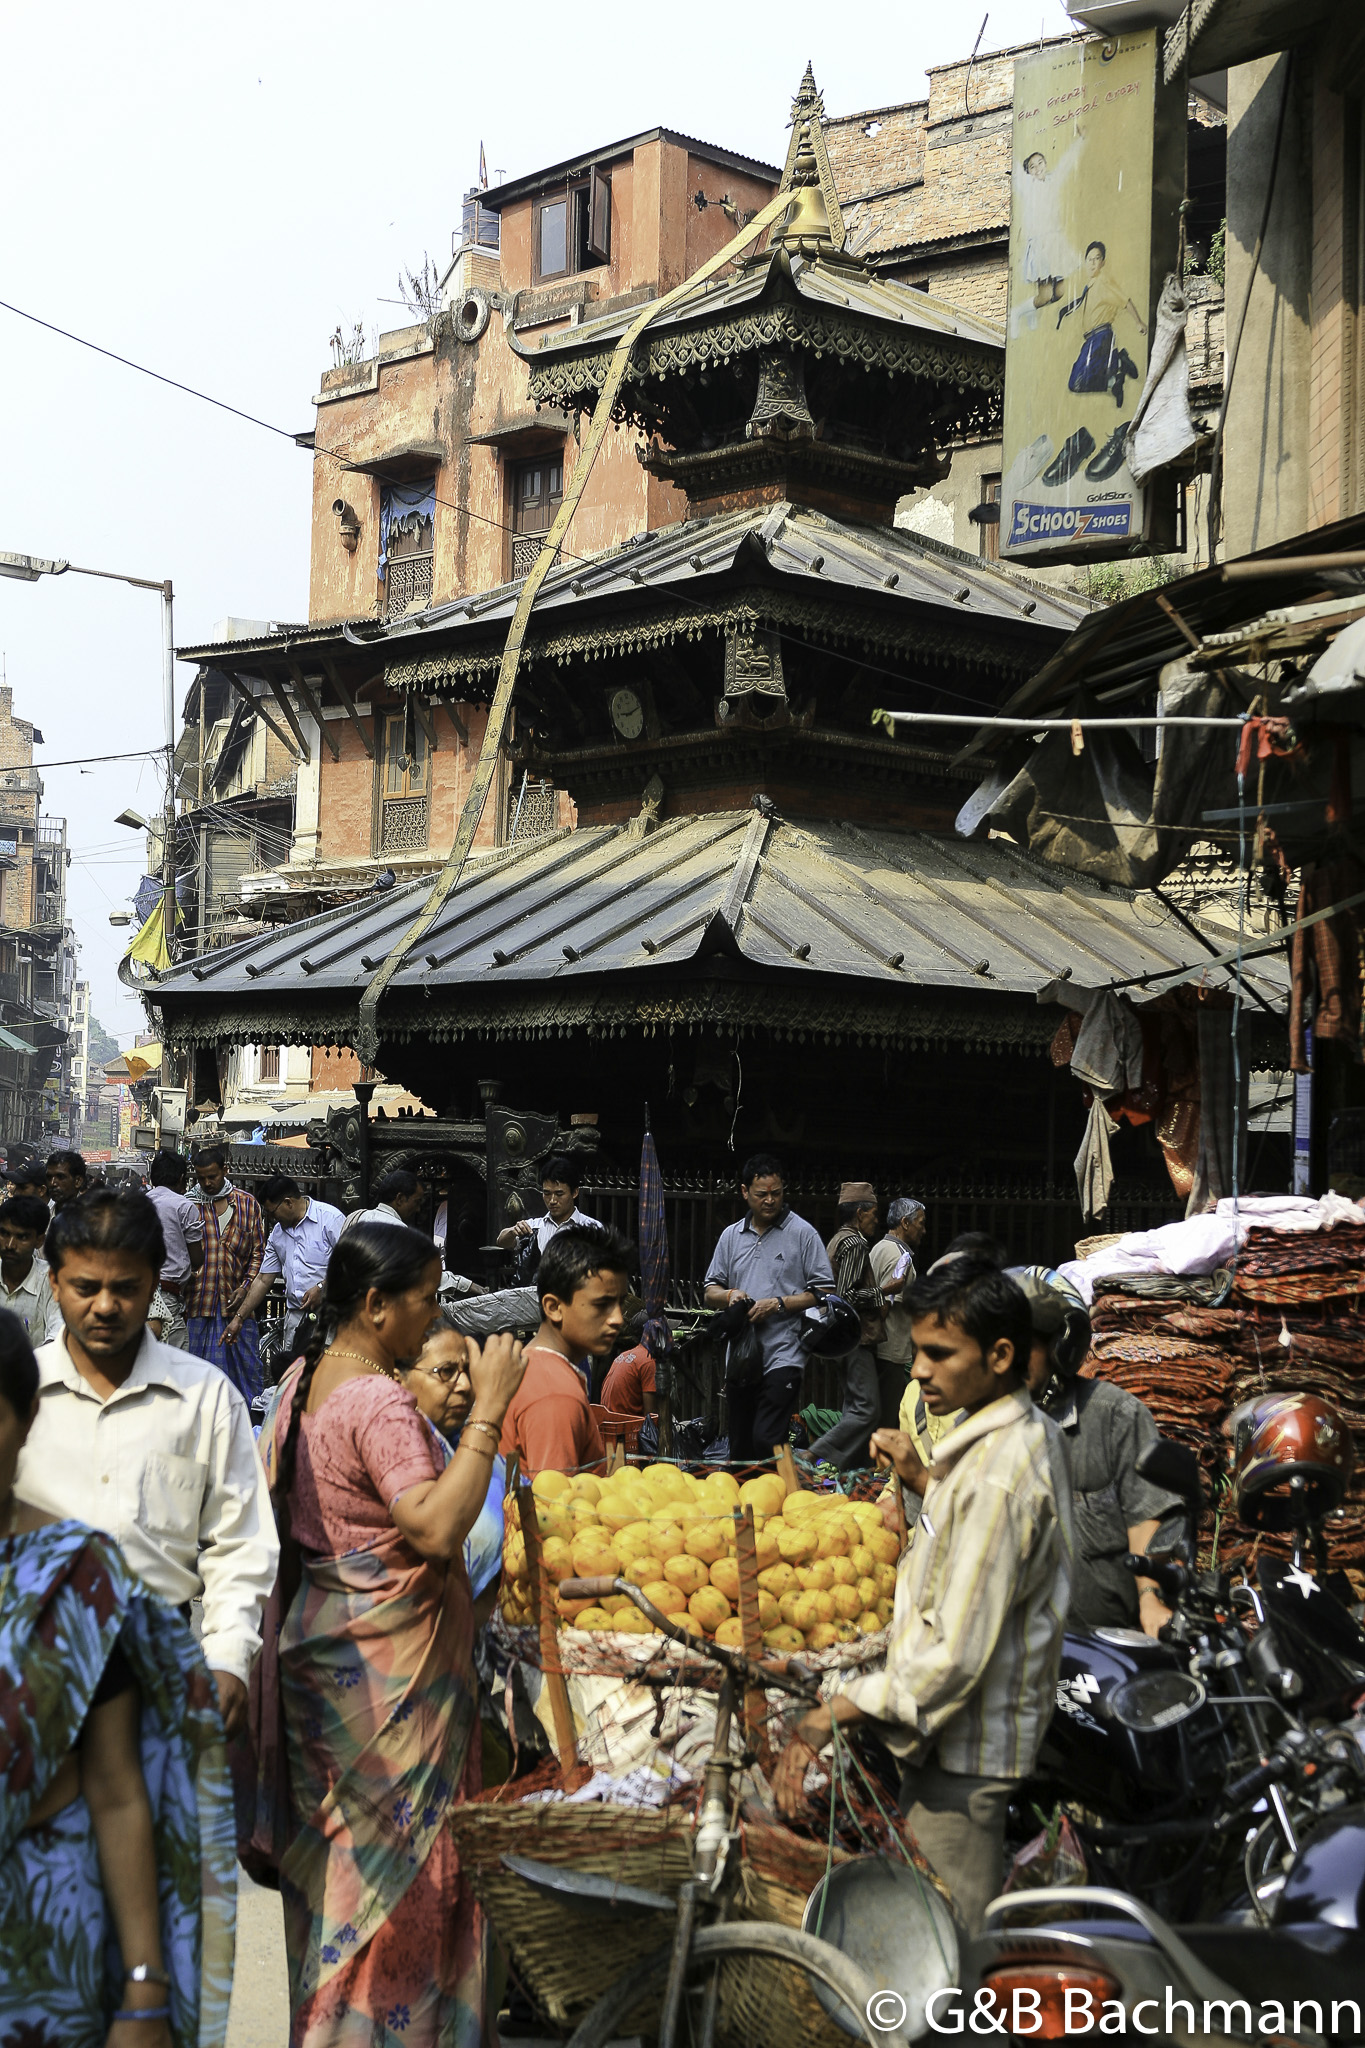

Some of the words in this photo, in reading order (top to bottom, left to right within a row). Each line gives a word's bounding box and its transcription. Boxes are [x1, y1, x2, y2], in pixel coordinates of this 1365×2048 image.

[1052, 56, 1097, 69] UNIVESAL
[1017, 108, 1040, 121] Fun
[1046, 85, 1087, 108] Frenzy
[1052, 96, 1098, 127] School
[1105, 81, 1140, 102] Crazy
[1092, 514, 1127, 528] SHOES
